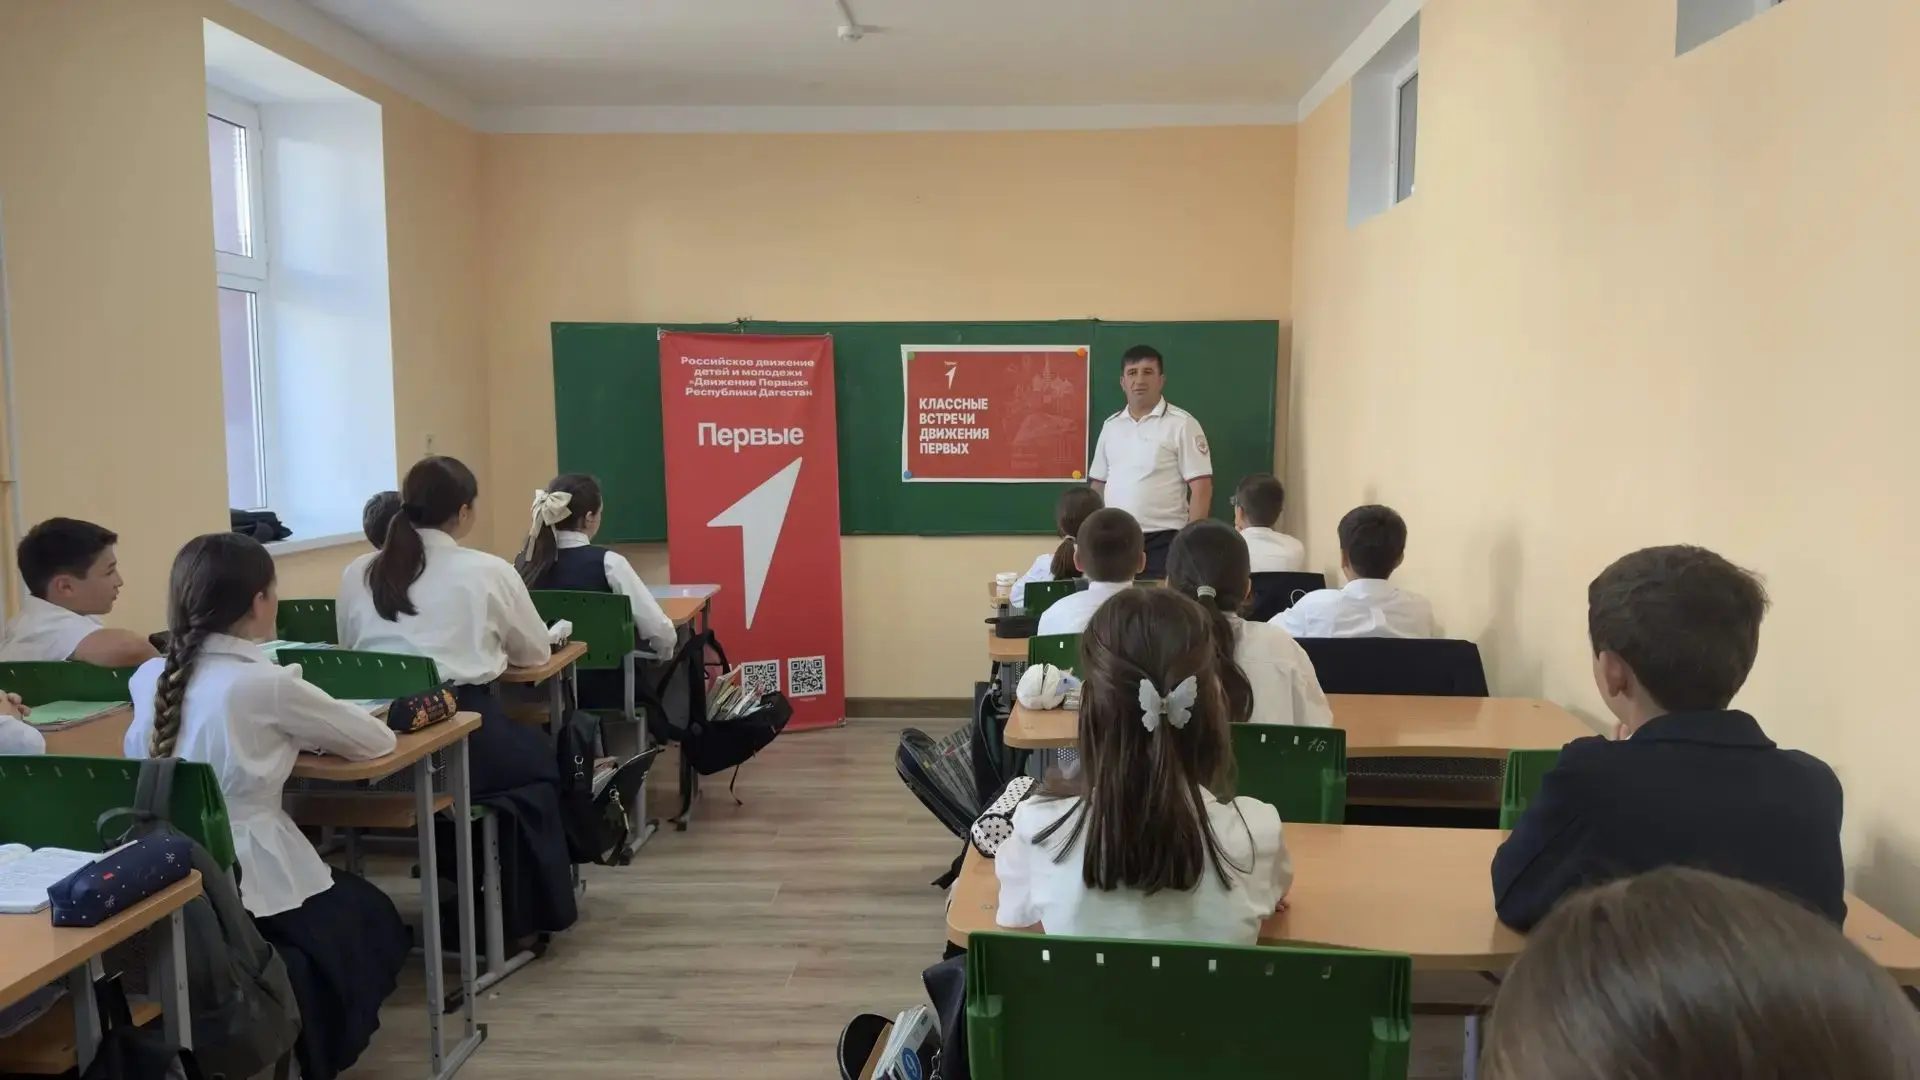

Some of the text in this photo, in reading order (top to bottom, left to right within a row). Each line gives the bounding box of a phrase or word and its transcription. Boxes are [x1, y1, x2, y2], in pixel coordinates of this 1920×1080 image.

[681, 356, 815, 367] Российское движение
[694, 367, 730, 376] детей
[690, 377, 808, 388] «Движение Первых»
[685, 387, 813, 398] Республики Дагестан
[919, 398, 988, 410] КЛАССНЫЕ
[919, 413, 976, 425] ВСТРЕЧИ
[698, 422, 804, 453] Первые
[919, 428, 990, 442] ДВИЖЕНИЯ
[919, 443, 969, 454] ПЕРВЫХ
